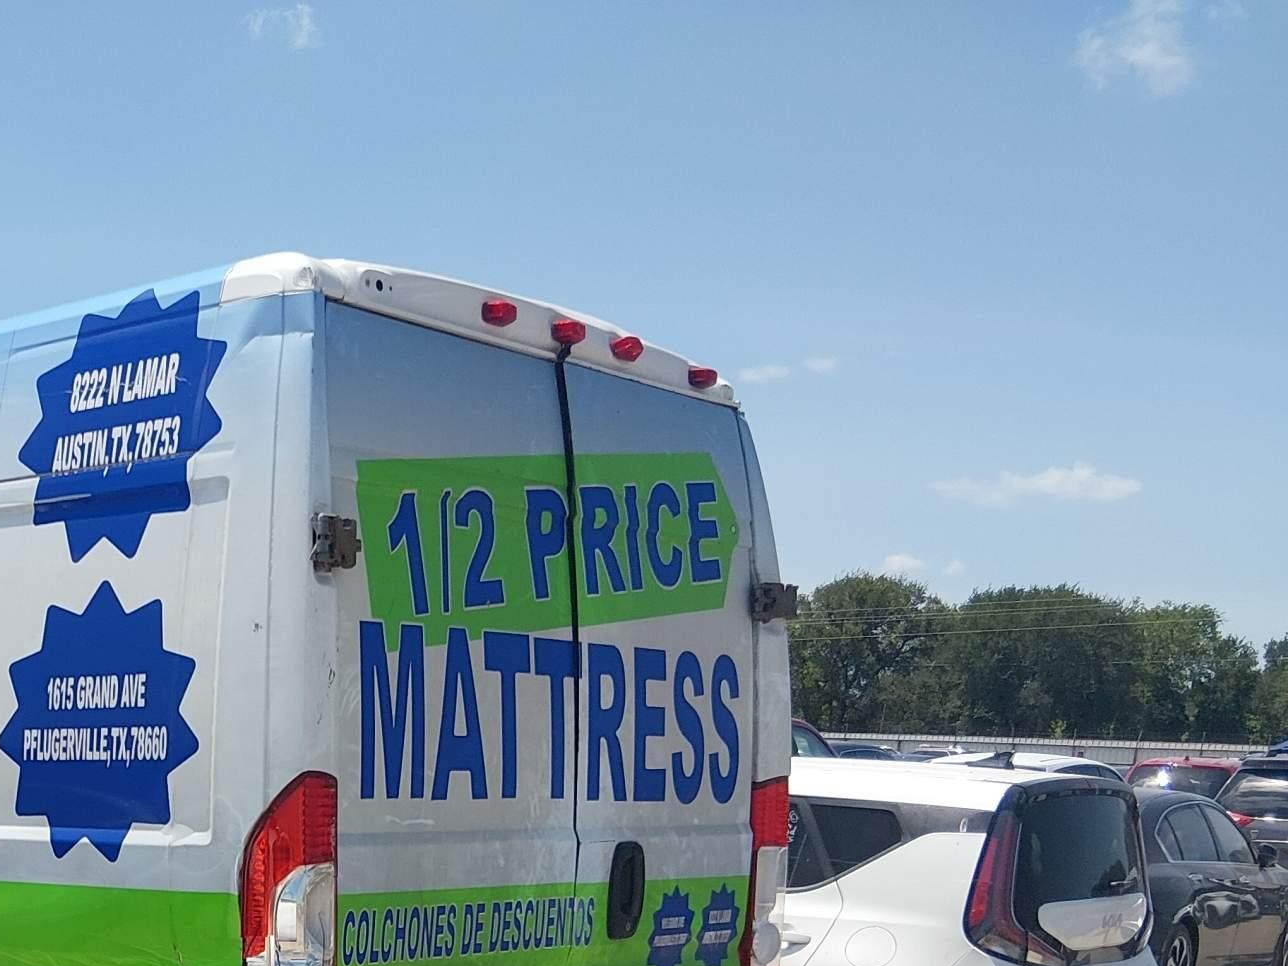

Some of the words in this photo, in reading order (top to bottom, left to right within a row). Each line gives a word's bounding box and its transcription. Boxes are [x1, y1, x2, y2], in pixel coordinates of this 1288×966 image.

[70, 367, 107, 414] 8222
[107, 363, 124, 406] N
[123, 352, 180, 403] LAMAR
[388, 488, 505, 617] 1/2
[525, 481, 722, 601] PRICE
[47, 677, 74, 711] 1615
[76, 674, 119, 710] GRAND
[120, 673, 147, 708] AVE
[360, 620, 740, 805] MATTRESS
[460, 901, 486, 957] DE
[488, 896, 594, 953] DESCUENTOS
